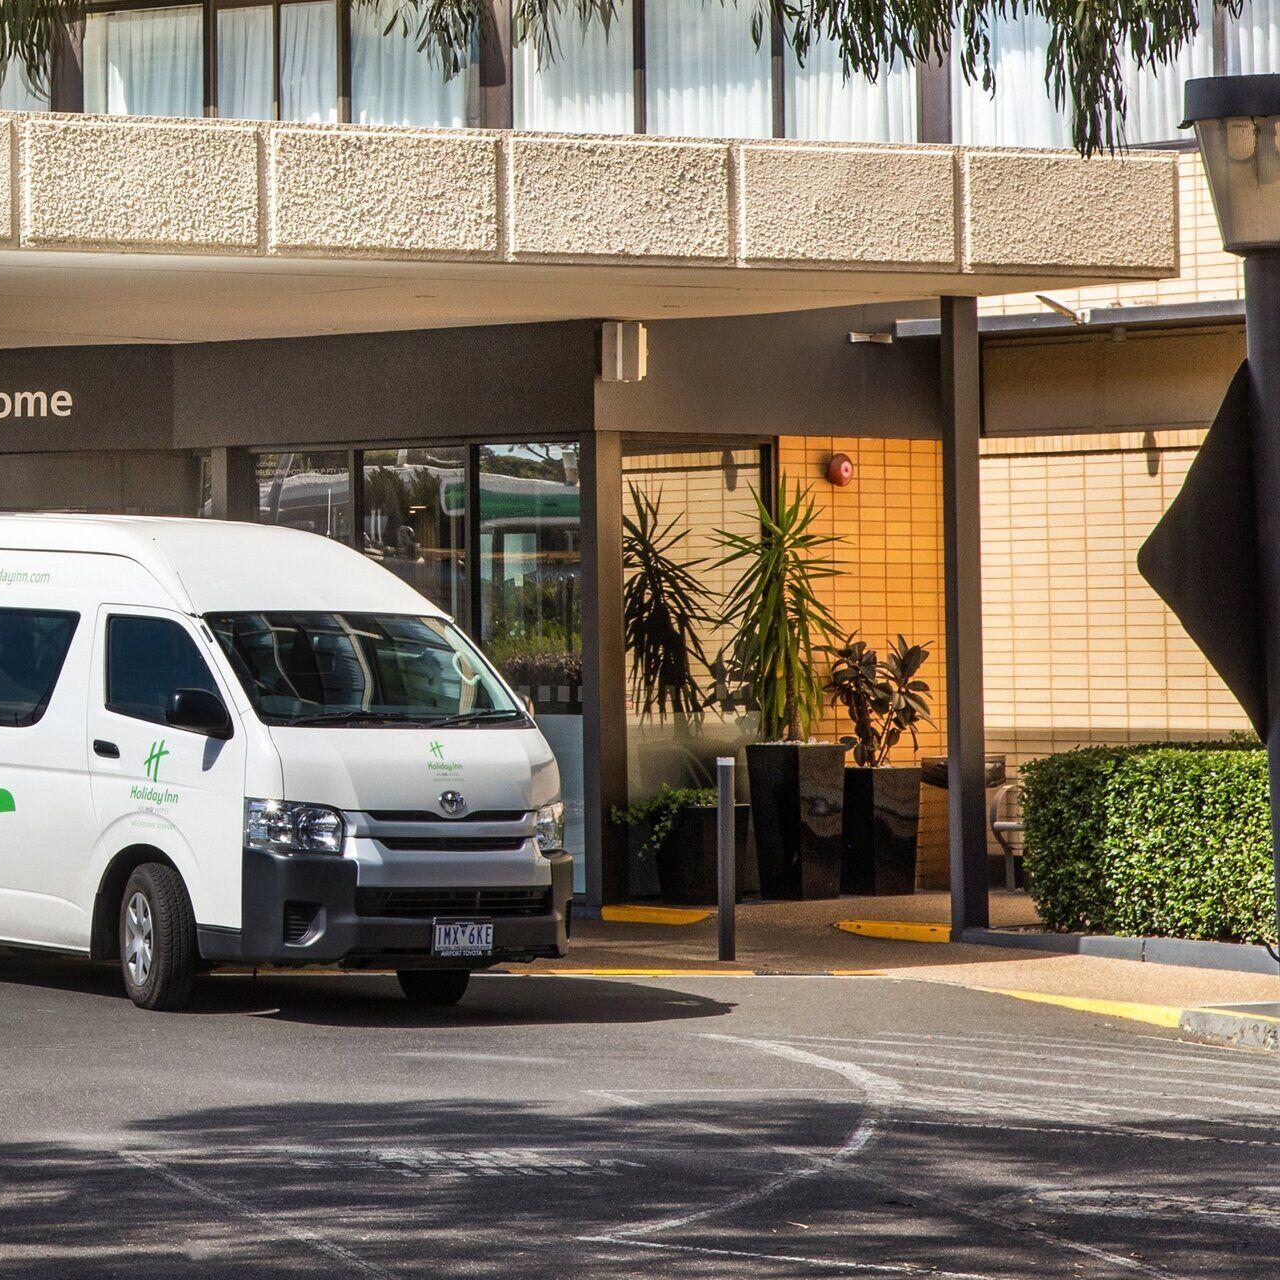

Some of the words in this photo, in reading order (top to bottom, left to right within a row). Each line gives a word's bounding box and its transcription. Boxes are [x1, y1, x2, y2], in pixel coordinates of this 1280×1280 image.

[130, 785, 164, 805] Holiday
[164, 788, 179, 803] Inn
[438, 926, 459, 946] 1MX
[469, 926, 491, 944] 6KE
